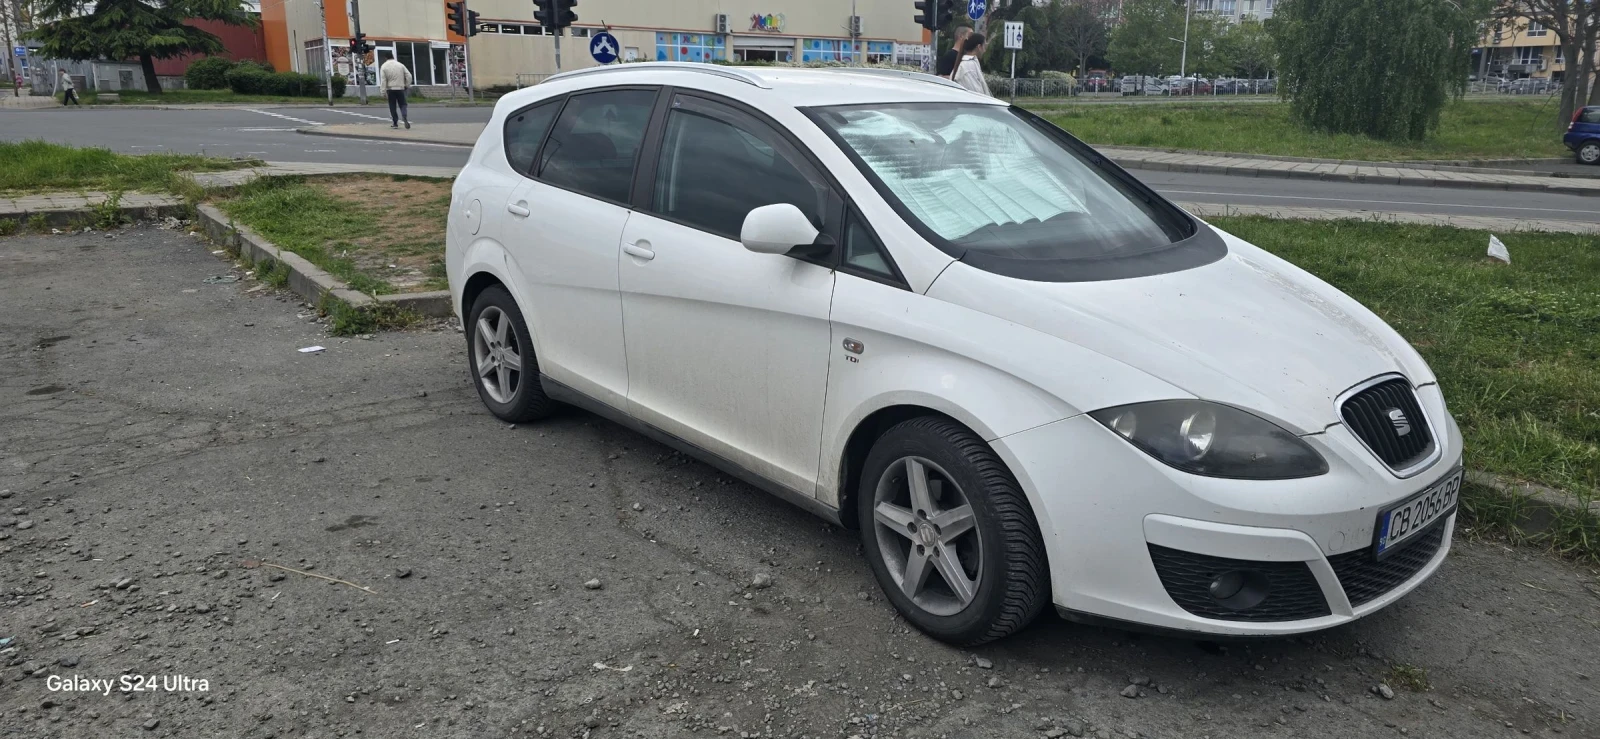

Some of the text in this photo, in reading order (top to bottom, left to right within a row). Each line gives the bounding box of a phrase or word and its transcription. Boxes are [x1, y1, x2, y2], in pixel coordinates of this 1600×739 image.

[1390, 475, 1460, 541] CB 2056 BP
